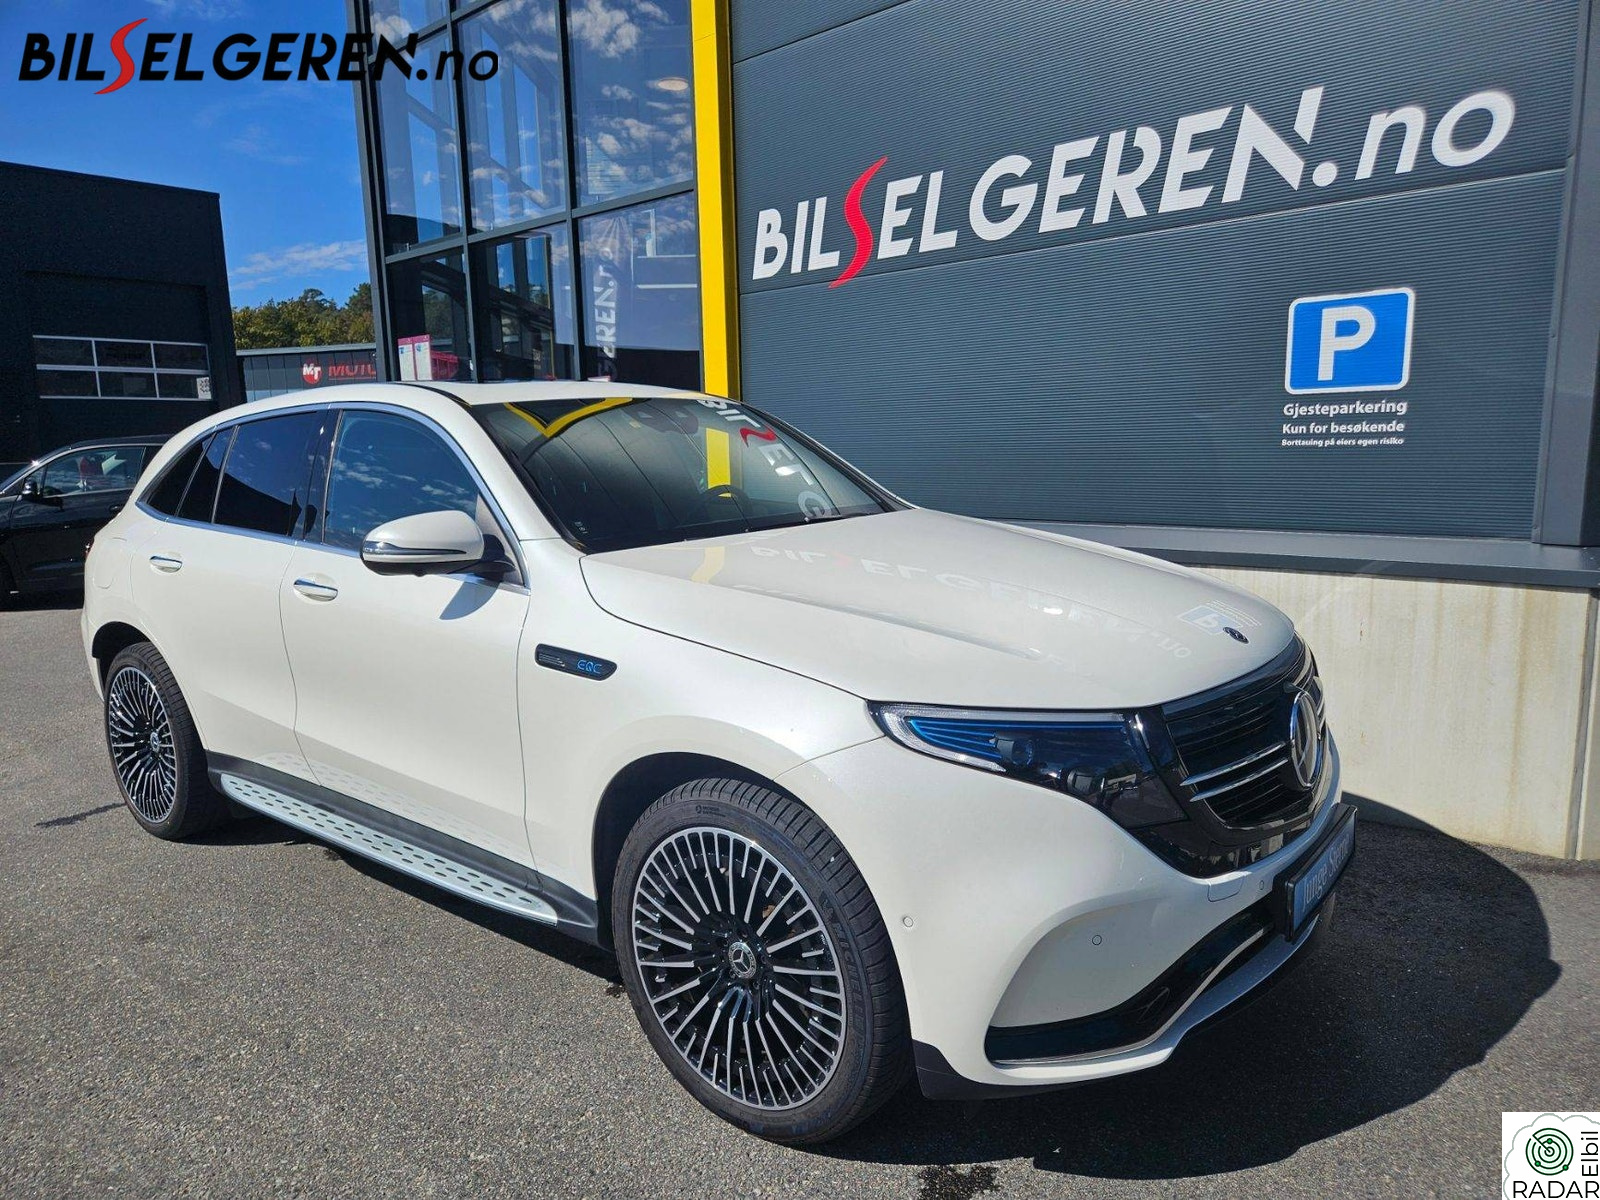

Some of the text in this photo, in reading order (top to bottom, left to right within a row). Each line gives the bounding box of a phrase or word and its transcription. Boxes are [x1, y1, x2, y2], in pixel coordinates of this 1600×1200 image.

[752, 86, 1516, 289] BILSELGEREN.no
[1317, 305, 1375, 381] P
[1283, 399, 1408, 418] Gjesteparkering
[1282, 420, 1405, 434] Kun for besøkende
[1281, 437, 1405, 447] Borttauing på eiers egen risiko
[577, 658, 603, 674] EQC
